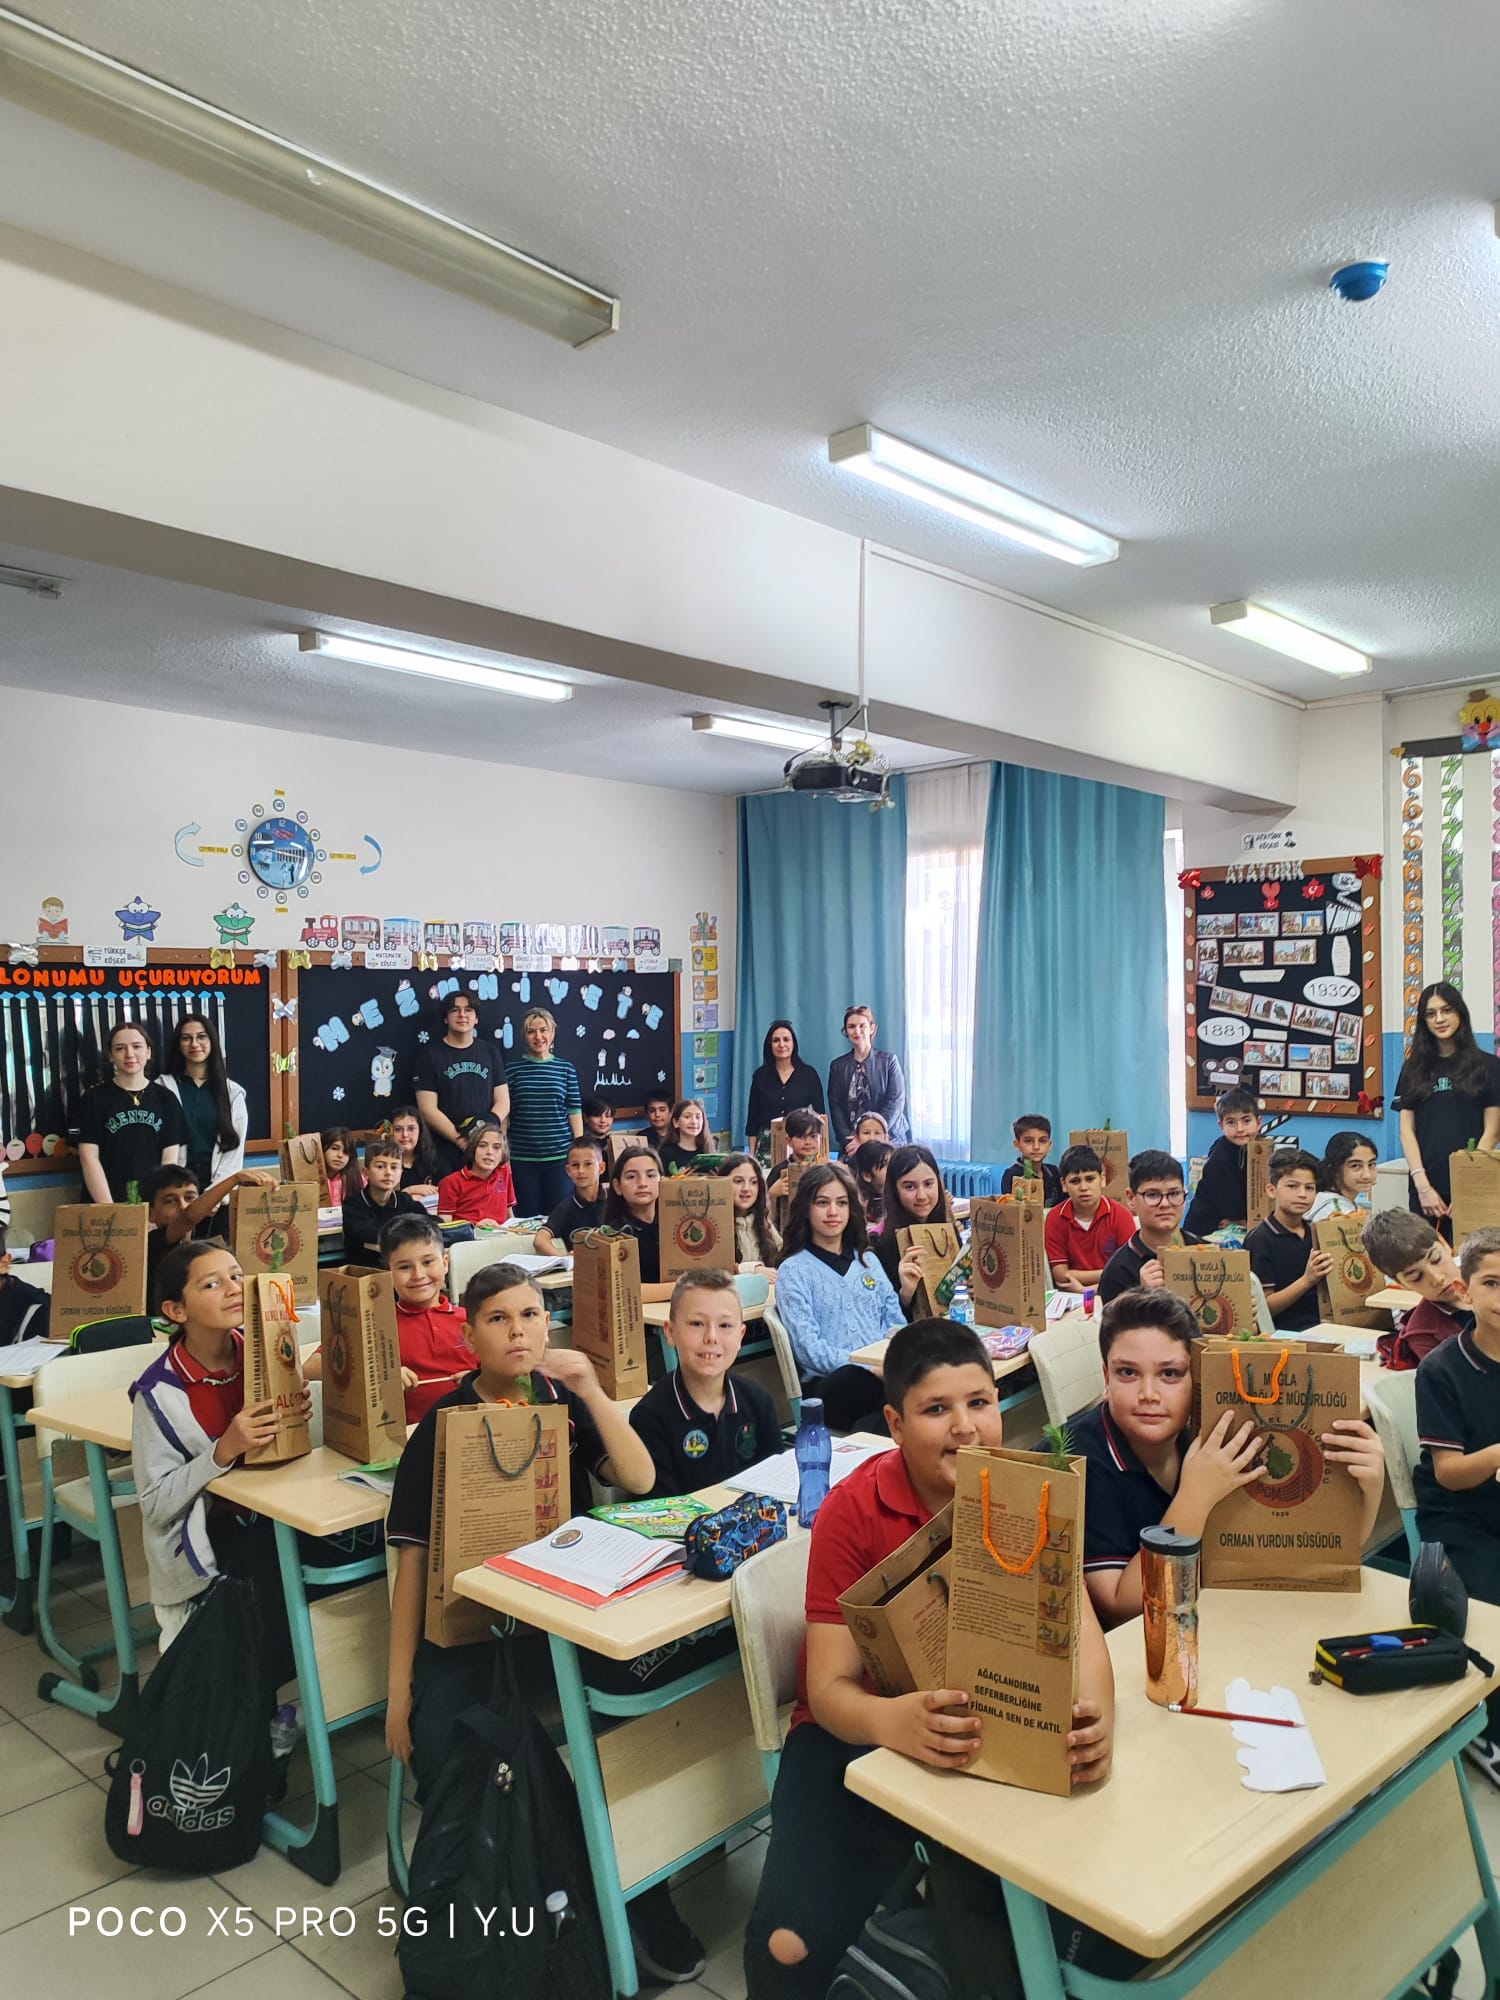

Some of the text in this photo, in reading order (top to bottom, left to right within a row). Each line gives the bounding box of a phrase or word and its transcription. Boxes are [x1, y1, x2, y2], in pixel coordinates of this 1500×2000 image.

[118, 969, 262, 991] UÇURUYORUM
[1201, 1024, 1245, 1037] 1881
[105, 1109, 164, 1134] MENTAL
[1219, 1531, 1342, 1549] ORMAN YURDUN SÜSÜDÜR
[977, 1667, 1040, 1694] AĞAÇLANDIRMA
[974, 1684, 1042, 1712] SEFERBERLİĞİNE
[970, 1699, 1003, 1718] FİDANLA
[1005, 1711, 1022, 1725] SEN
[1023, 1717, 1035, 1728] DE
[1037, 1719, 1062, 1734] KATIL
